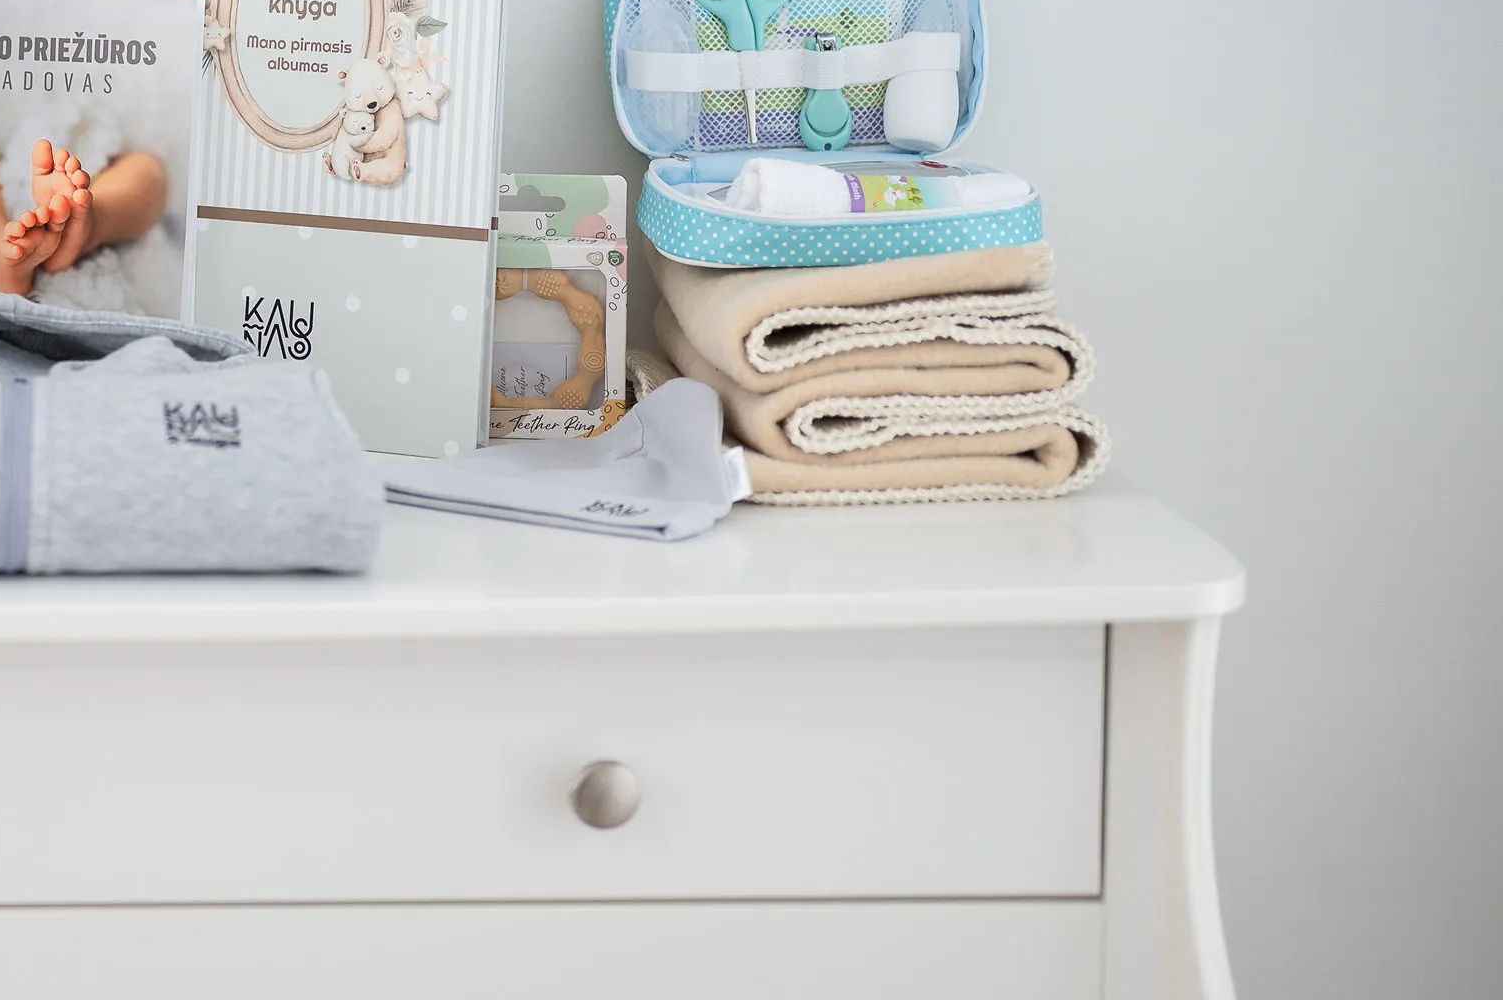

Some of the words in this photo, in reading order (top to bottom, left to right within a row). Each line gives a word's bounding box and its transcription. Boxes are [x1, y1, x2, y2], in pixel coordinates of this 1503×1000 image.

[18, 31, 157, 65] PRIEŽIŪROS
[246, 35, 286, 50] Mano
[290, 37, 352, 54] pirmasis
[267, 56, 329, 73] albumas
[244, 295, 315, 338] KAU
[513, 365, 529, 398] Teether
[533, 371, 551, 397] Ring
[509, 413, 560, 433] Teether
[563, 415, 595, 438] Ring
